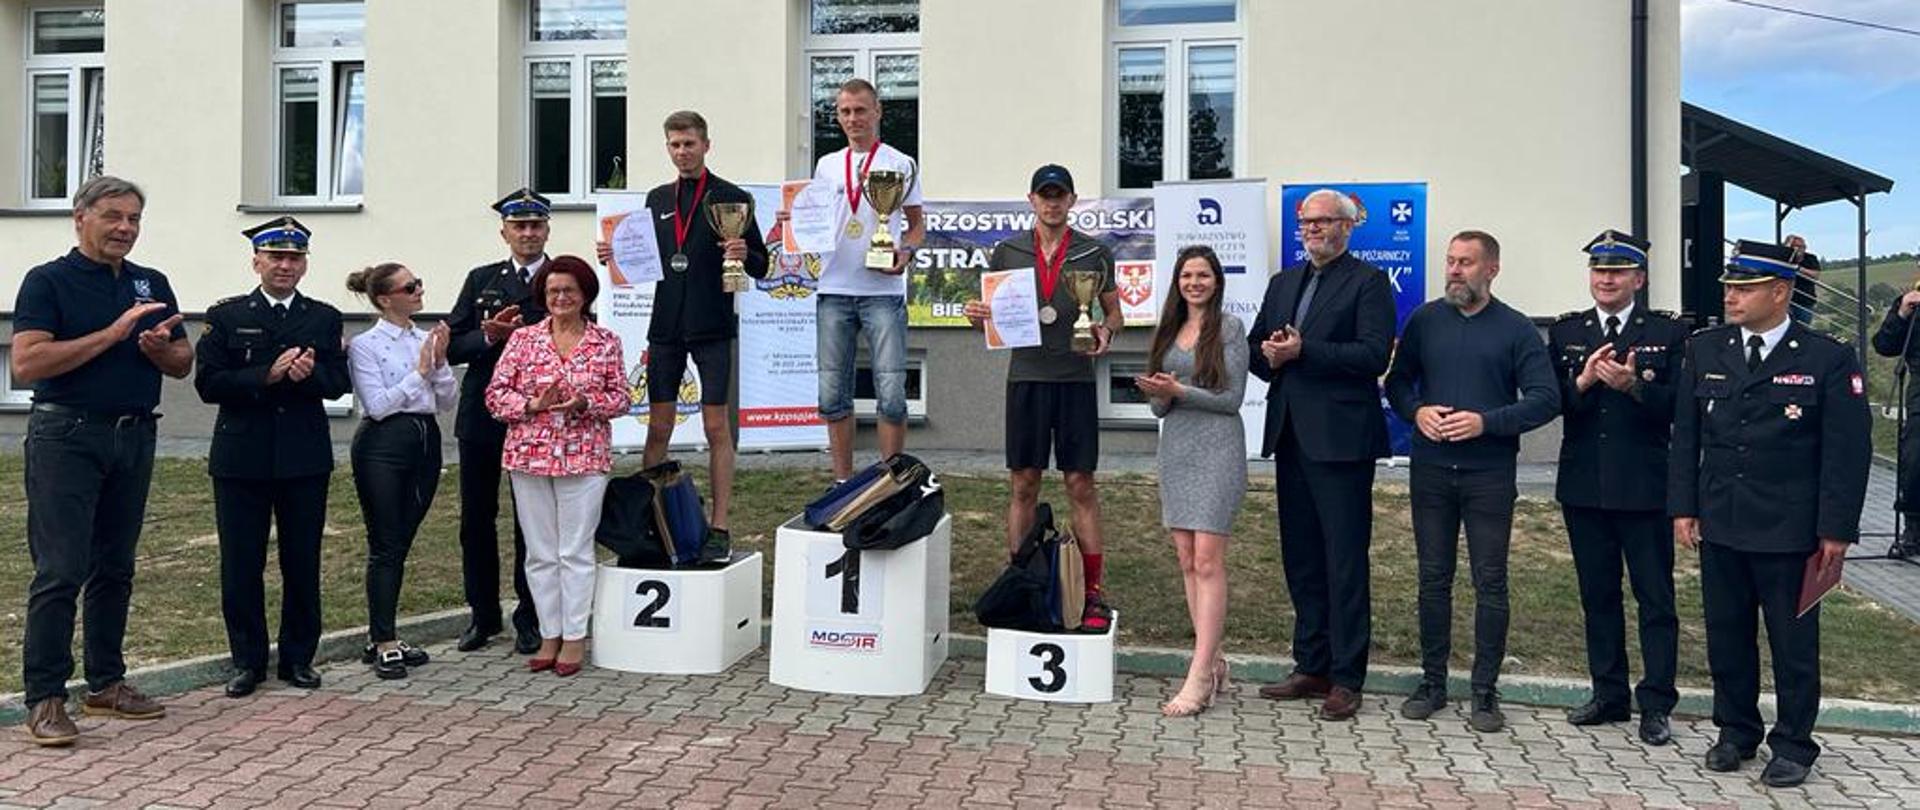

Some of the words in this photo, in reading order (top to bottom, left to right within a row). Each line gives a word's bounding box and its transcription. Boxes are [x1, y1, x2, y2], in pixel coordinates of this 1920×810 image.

[633, 580, 671, 628] 2
[825, 549, 860, 614] 1
[1028, 642, 1068, 693] 3
